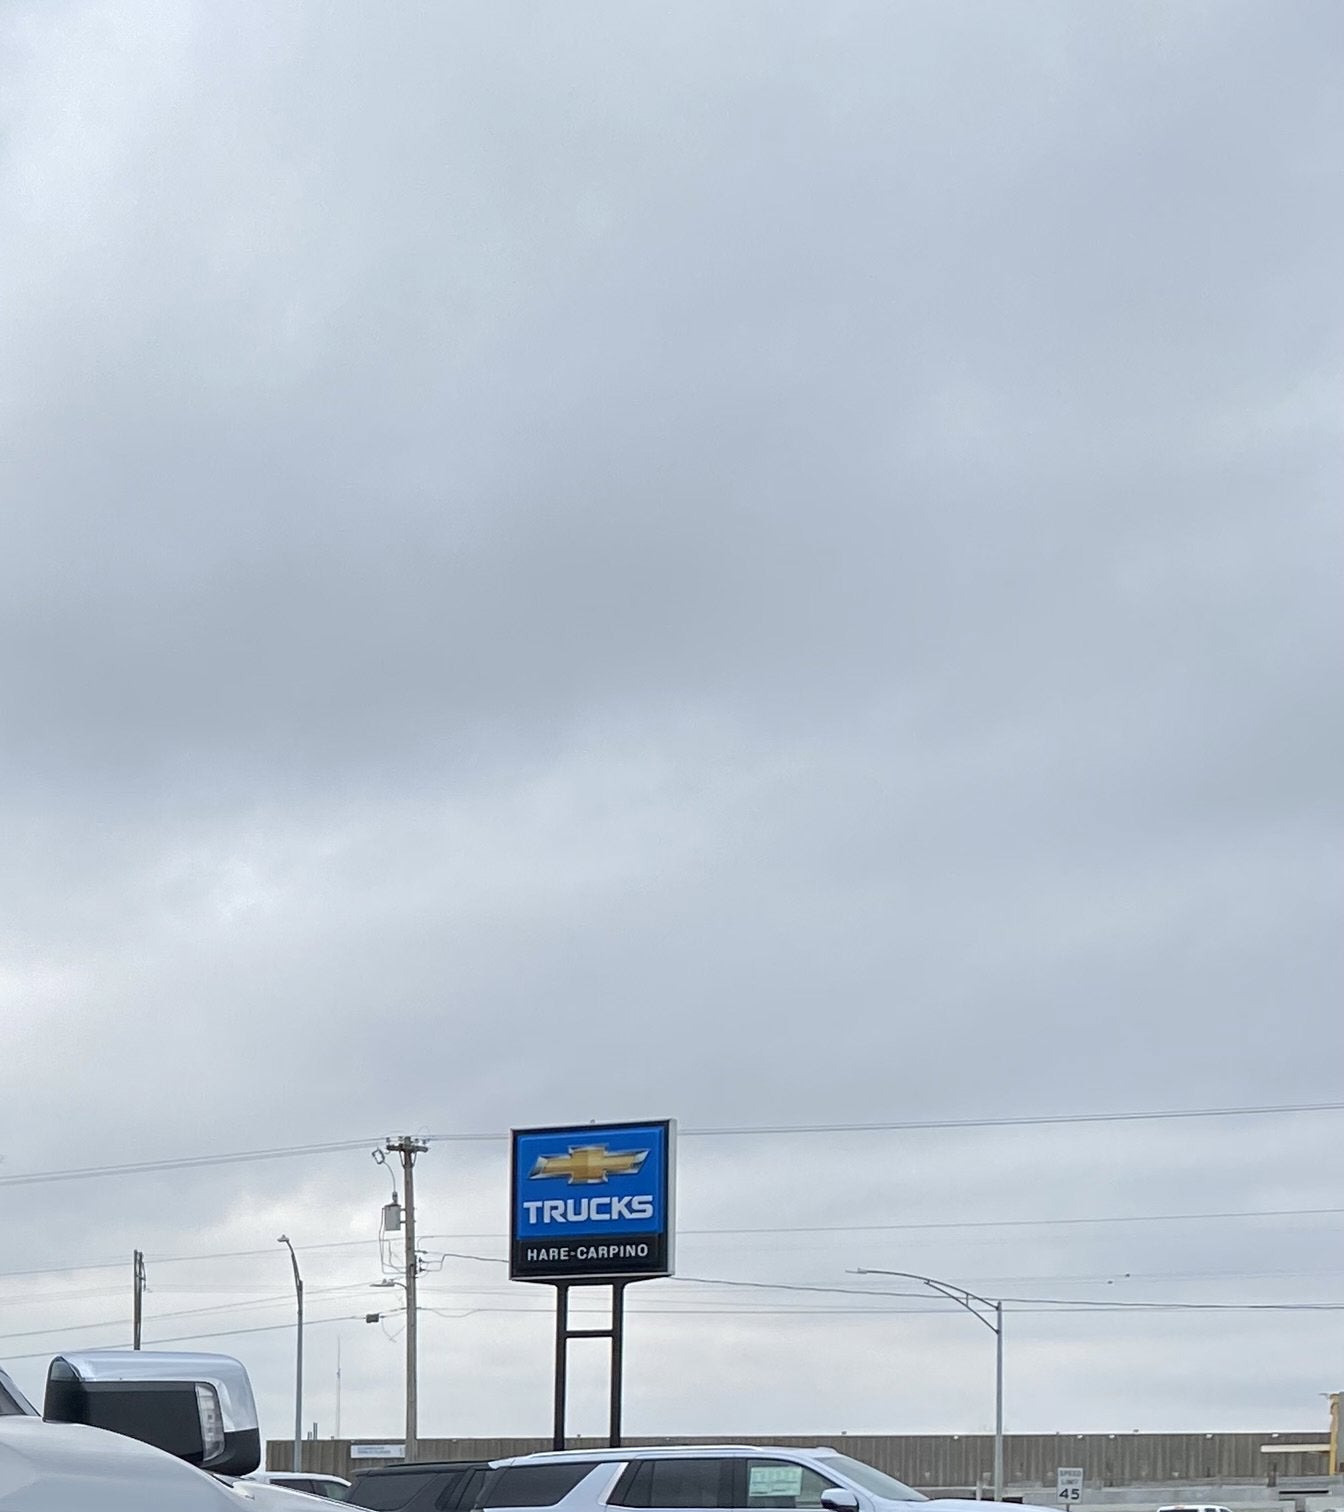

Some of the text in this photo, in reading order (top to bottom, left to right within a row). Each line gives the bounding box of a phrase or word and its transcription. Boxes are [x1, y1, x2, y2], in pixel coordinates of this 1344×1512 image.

[523, 1195, 653, 1224] TRUCKS
[527, 1244, 649, 1261] HARE-CARPINO
[1059, 1488, 1080, 1500] 45
